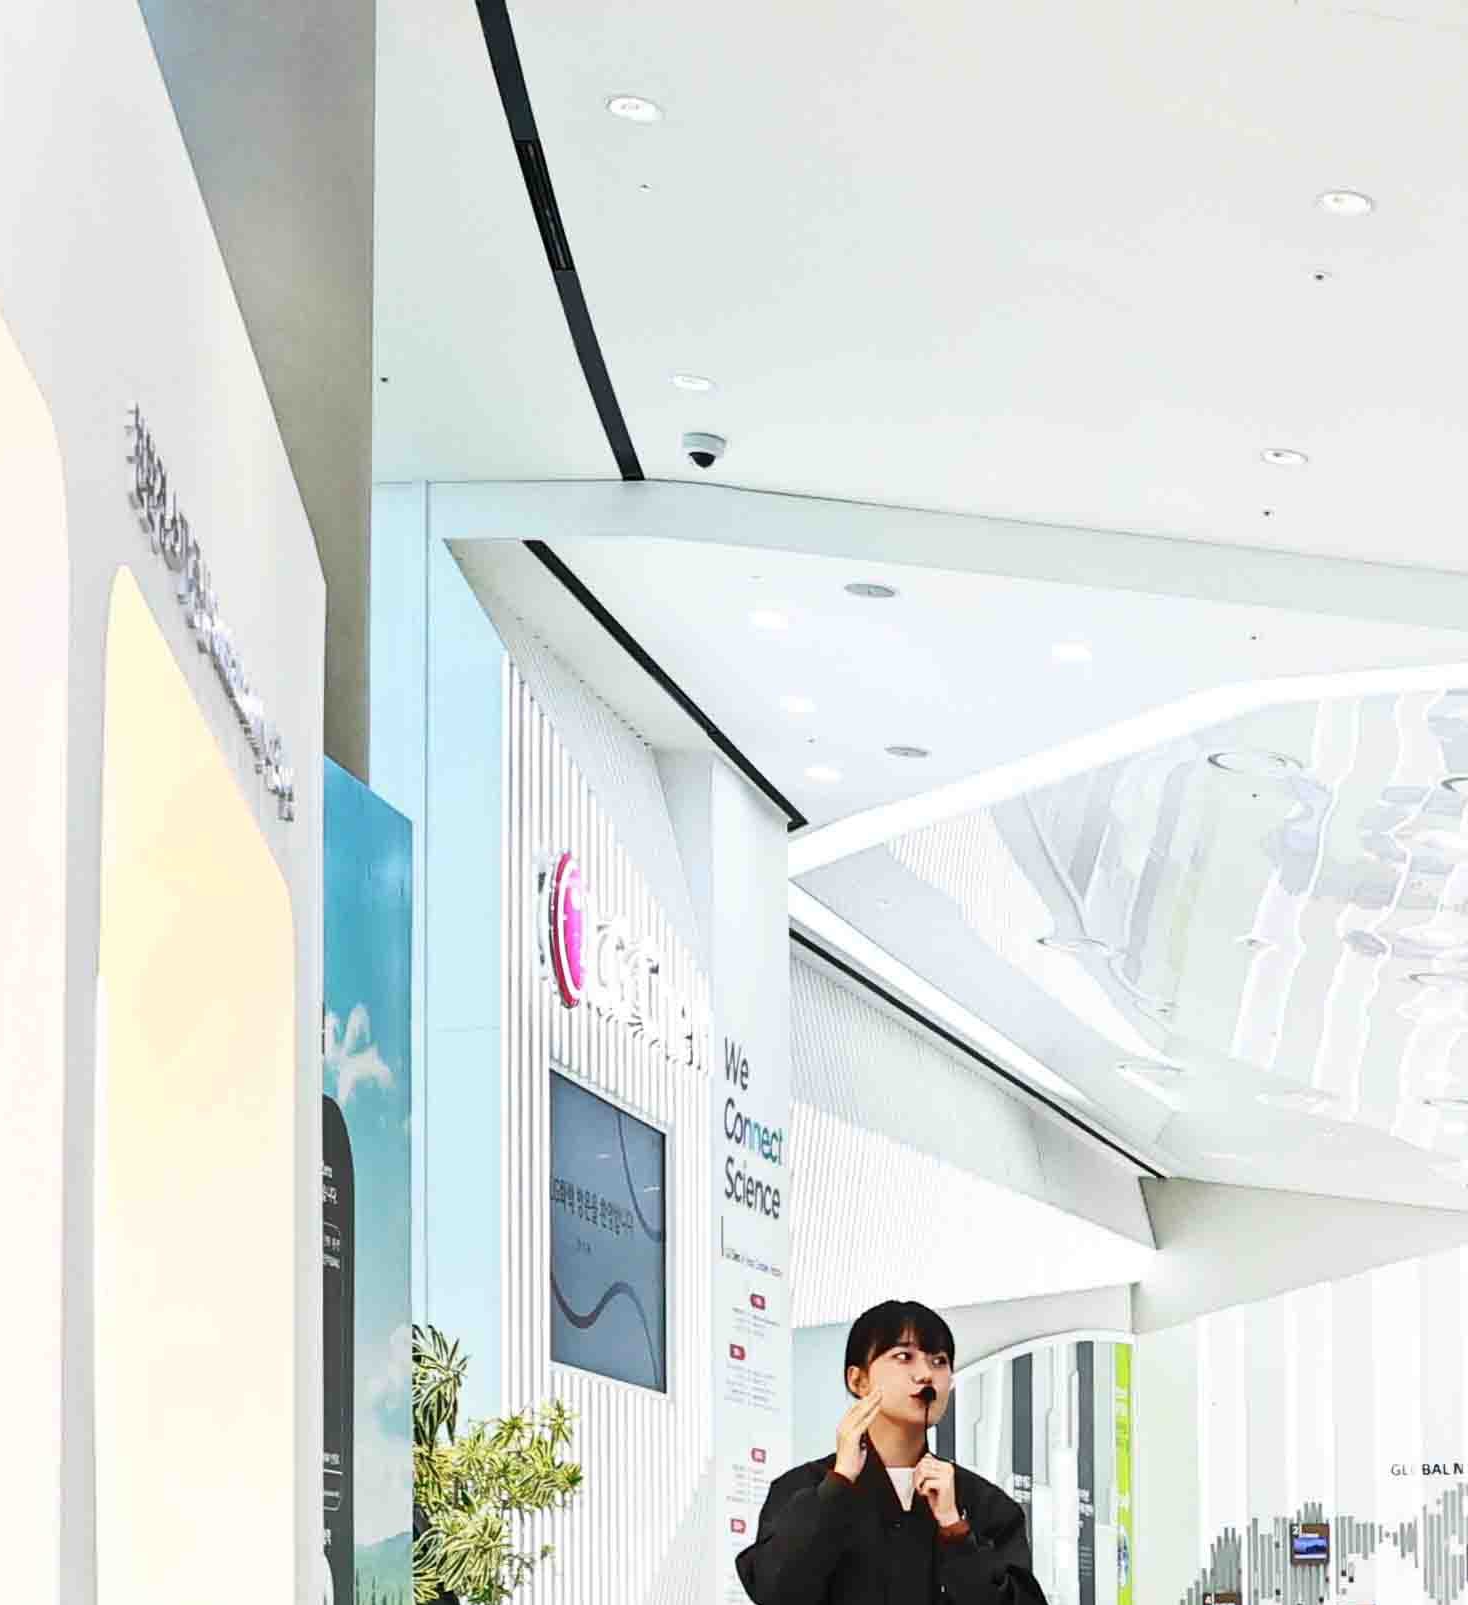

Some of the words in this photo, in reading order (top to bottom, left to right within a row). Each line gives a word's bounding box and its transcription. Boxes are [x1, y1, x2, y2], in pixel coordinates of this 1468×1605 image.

[724, 1036, 749, 1091] We
[724, 1097, 784, 1166] Connect
[724, 1156, 780, 1220] Science
[1390, 1463, 1451, 1476] GLBAL
